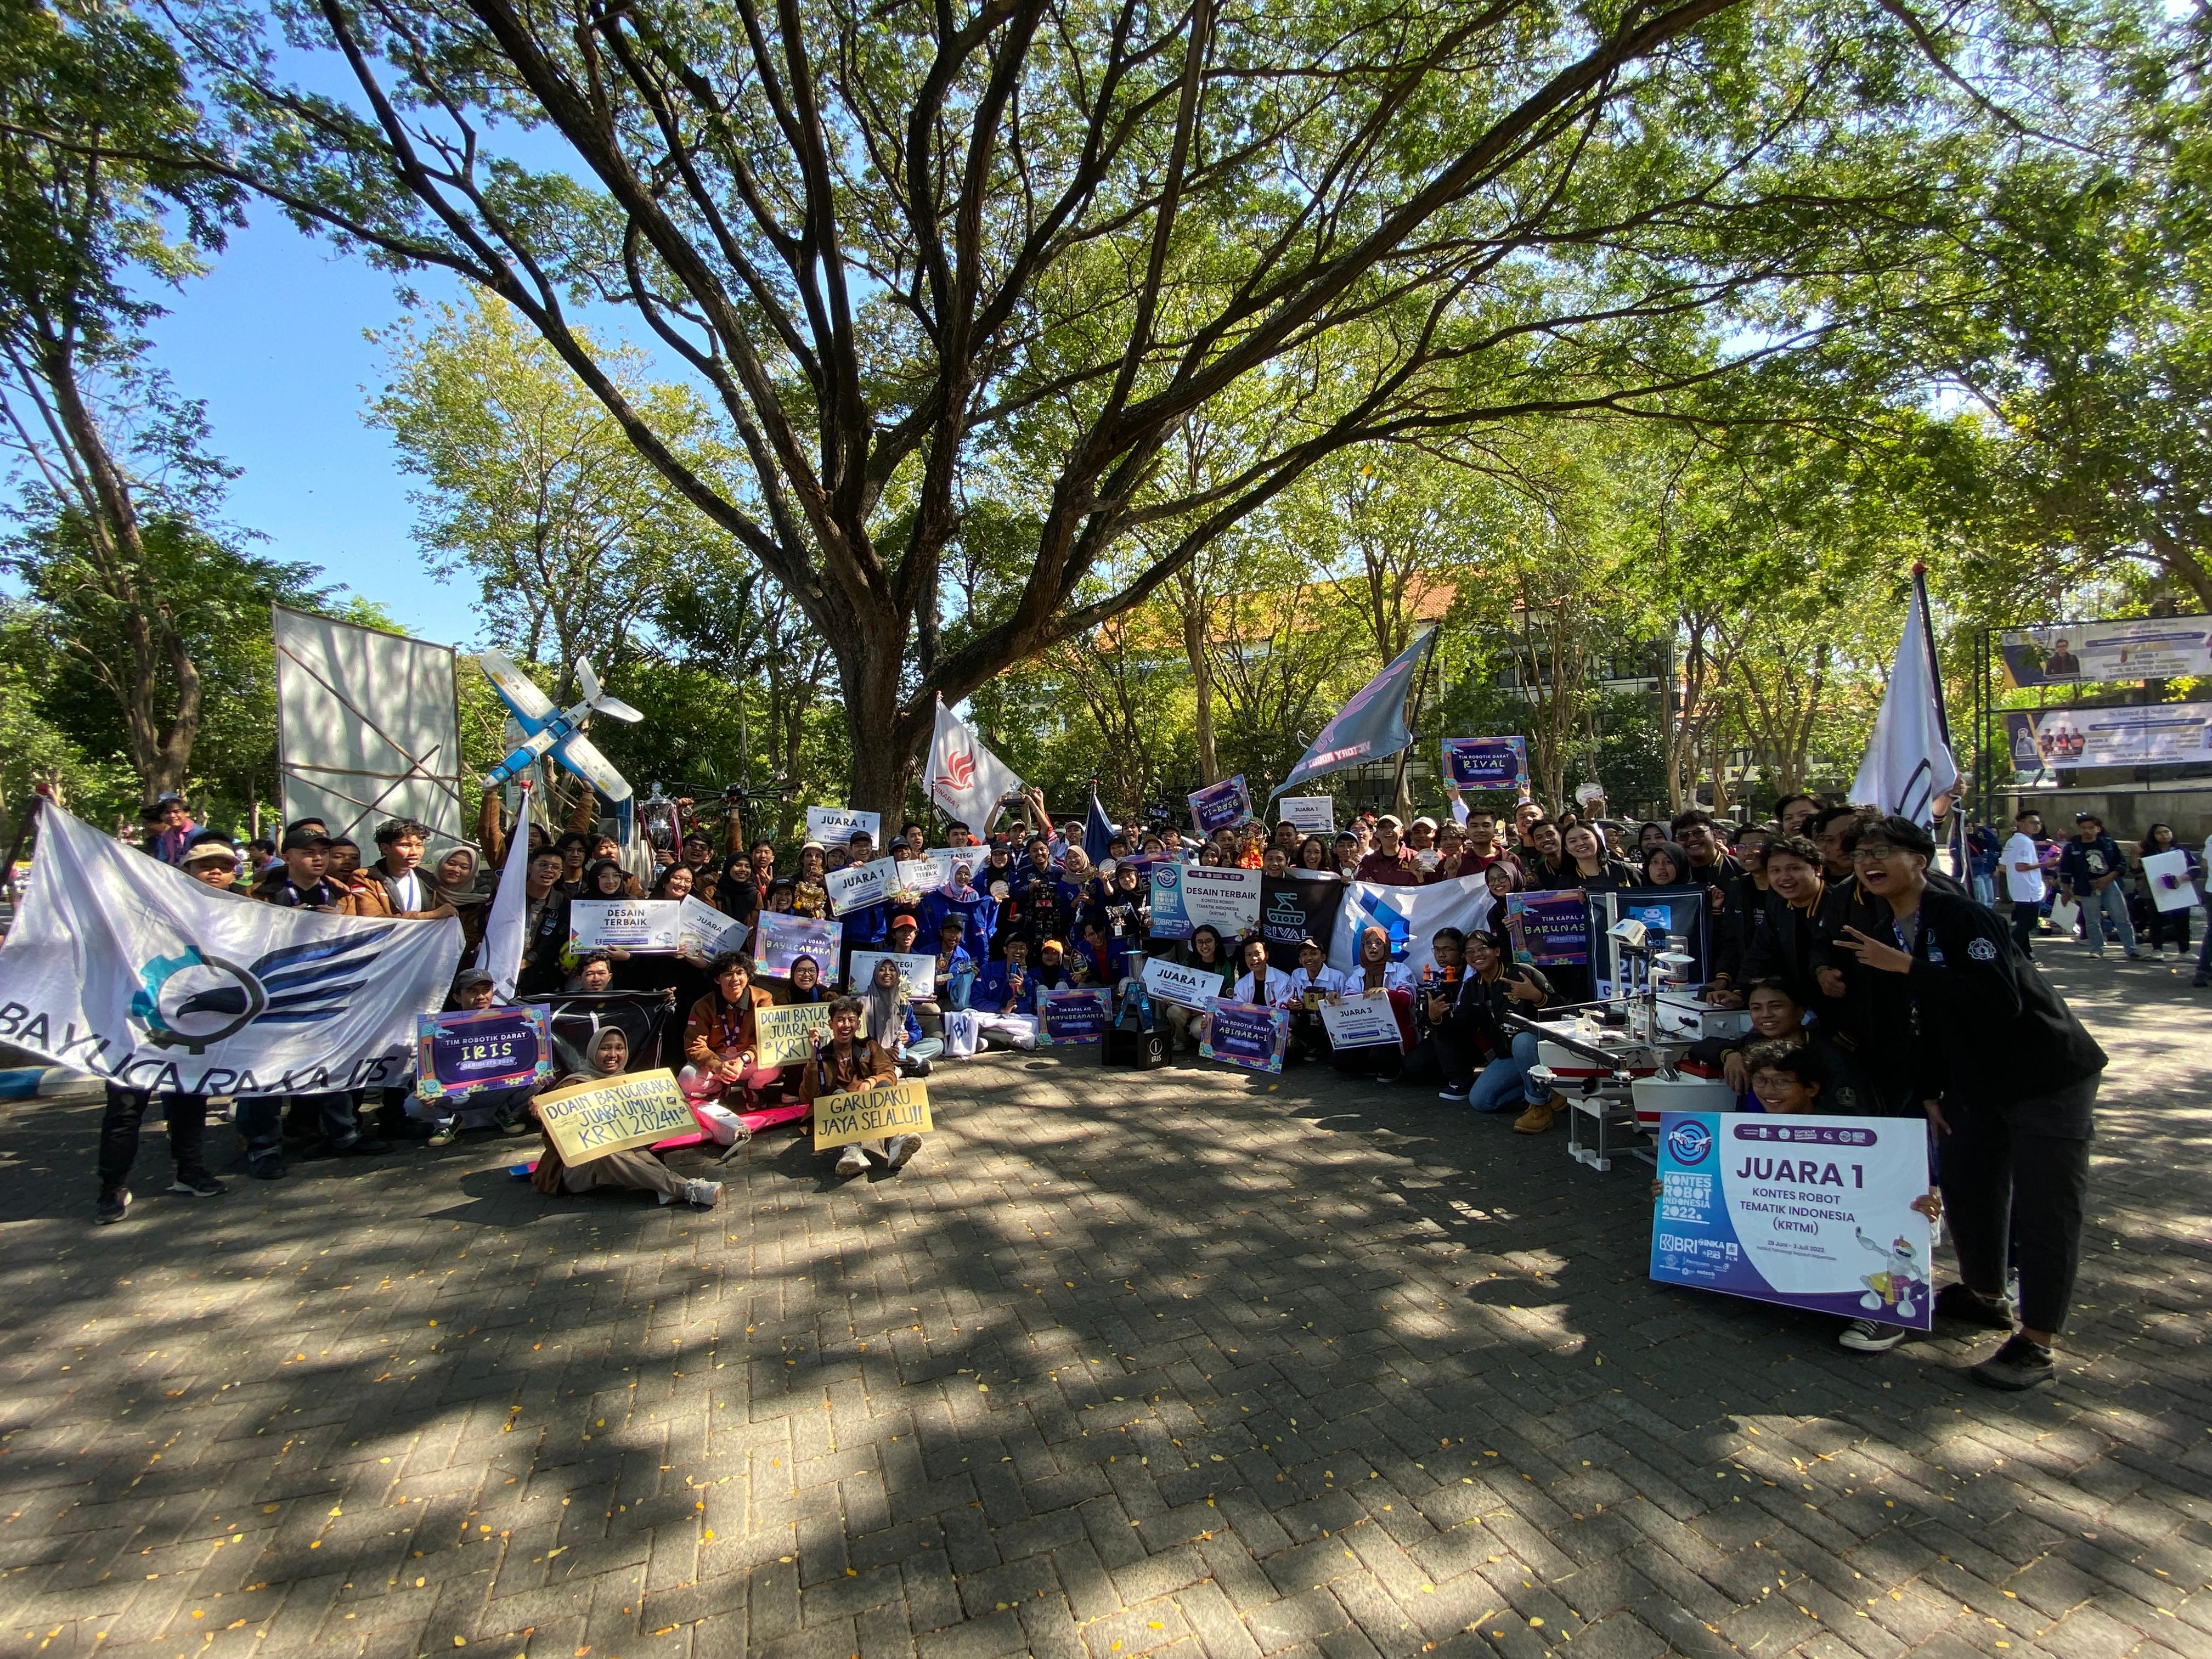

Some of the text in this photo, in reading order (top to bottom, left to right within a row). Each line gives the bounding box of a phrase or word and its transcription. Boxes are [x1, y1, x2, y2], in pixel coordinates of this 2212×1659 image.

[1463, 760, 1505, 769] RIVAL
[821, 815, 866, 828] JUARA 1
[913, 864, 939, 872] STRATEGI
[842, 871, 878, 889] JUARA
[879, 868, 885, 877] 1
[1186, 887, 1257, 900] DESAIN TERBAIK
[607, 909, 645, 917] DESAIN
[696, 915, 722, 933] JUARA
[1263, 924, 1313, 939] RIVAL
[1525, 923, 1585, 935] BARUNAS
[766, 940, 831, 955] BAYUCARAKA
[874, 960, 913, 968] STEGI
[1157, 969, 1206, 988] JUARA 1
[761, 1007, 831, 1025] DOAIN BAYUC
[1340, 1008, 1367, 1017] JUARA
[769, 1023, 809, 1039] JUARA
[1229, 1020, 1252, 1029] ROBOTIK
[462, 1035, 498, 1044] ROBOTIK
[500, 1032, 527, 1040] DARAT
[1219, 1026, 1267, 1042] ABINARA-1
[461, 1042, 512, 1060] IRIS
[1151, 1054, 1161, 1063] IRIS
[346, 1056, 398, 1087] ITS
[545, 1079, 677, 1120] DOAIN BAYUCARAKA
[830, 1087, 911, 1114] GARUDAKU
[579, 1096, 666, 1127] JUARA UMUM
[819, 1105, 923, 1136] JAYA SELALU!!
[578, 1119, 629, 1149] KRTI
[1736, 1156, 1863, 1189] JUARA 1
[1664, 1174, 1712, 1188] KONTES
[1663, 1184, 1712, 1200] ROBOT
[1752, 1187, 1841, 1205] KONTES ROBOT
[1662, 1197, 1711, 1209] INDONESIA
[1740, 1200, 1855, 1223] TEMATIK INDONESIA
[1773, 1216, 1819, 1235] (KRTMI)
[1674, 1237, 1725, 1255] BRI INKA
